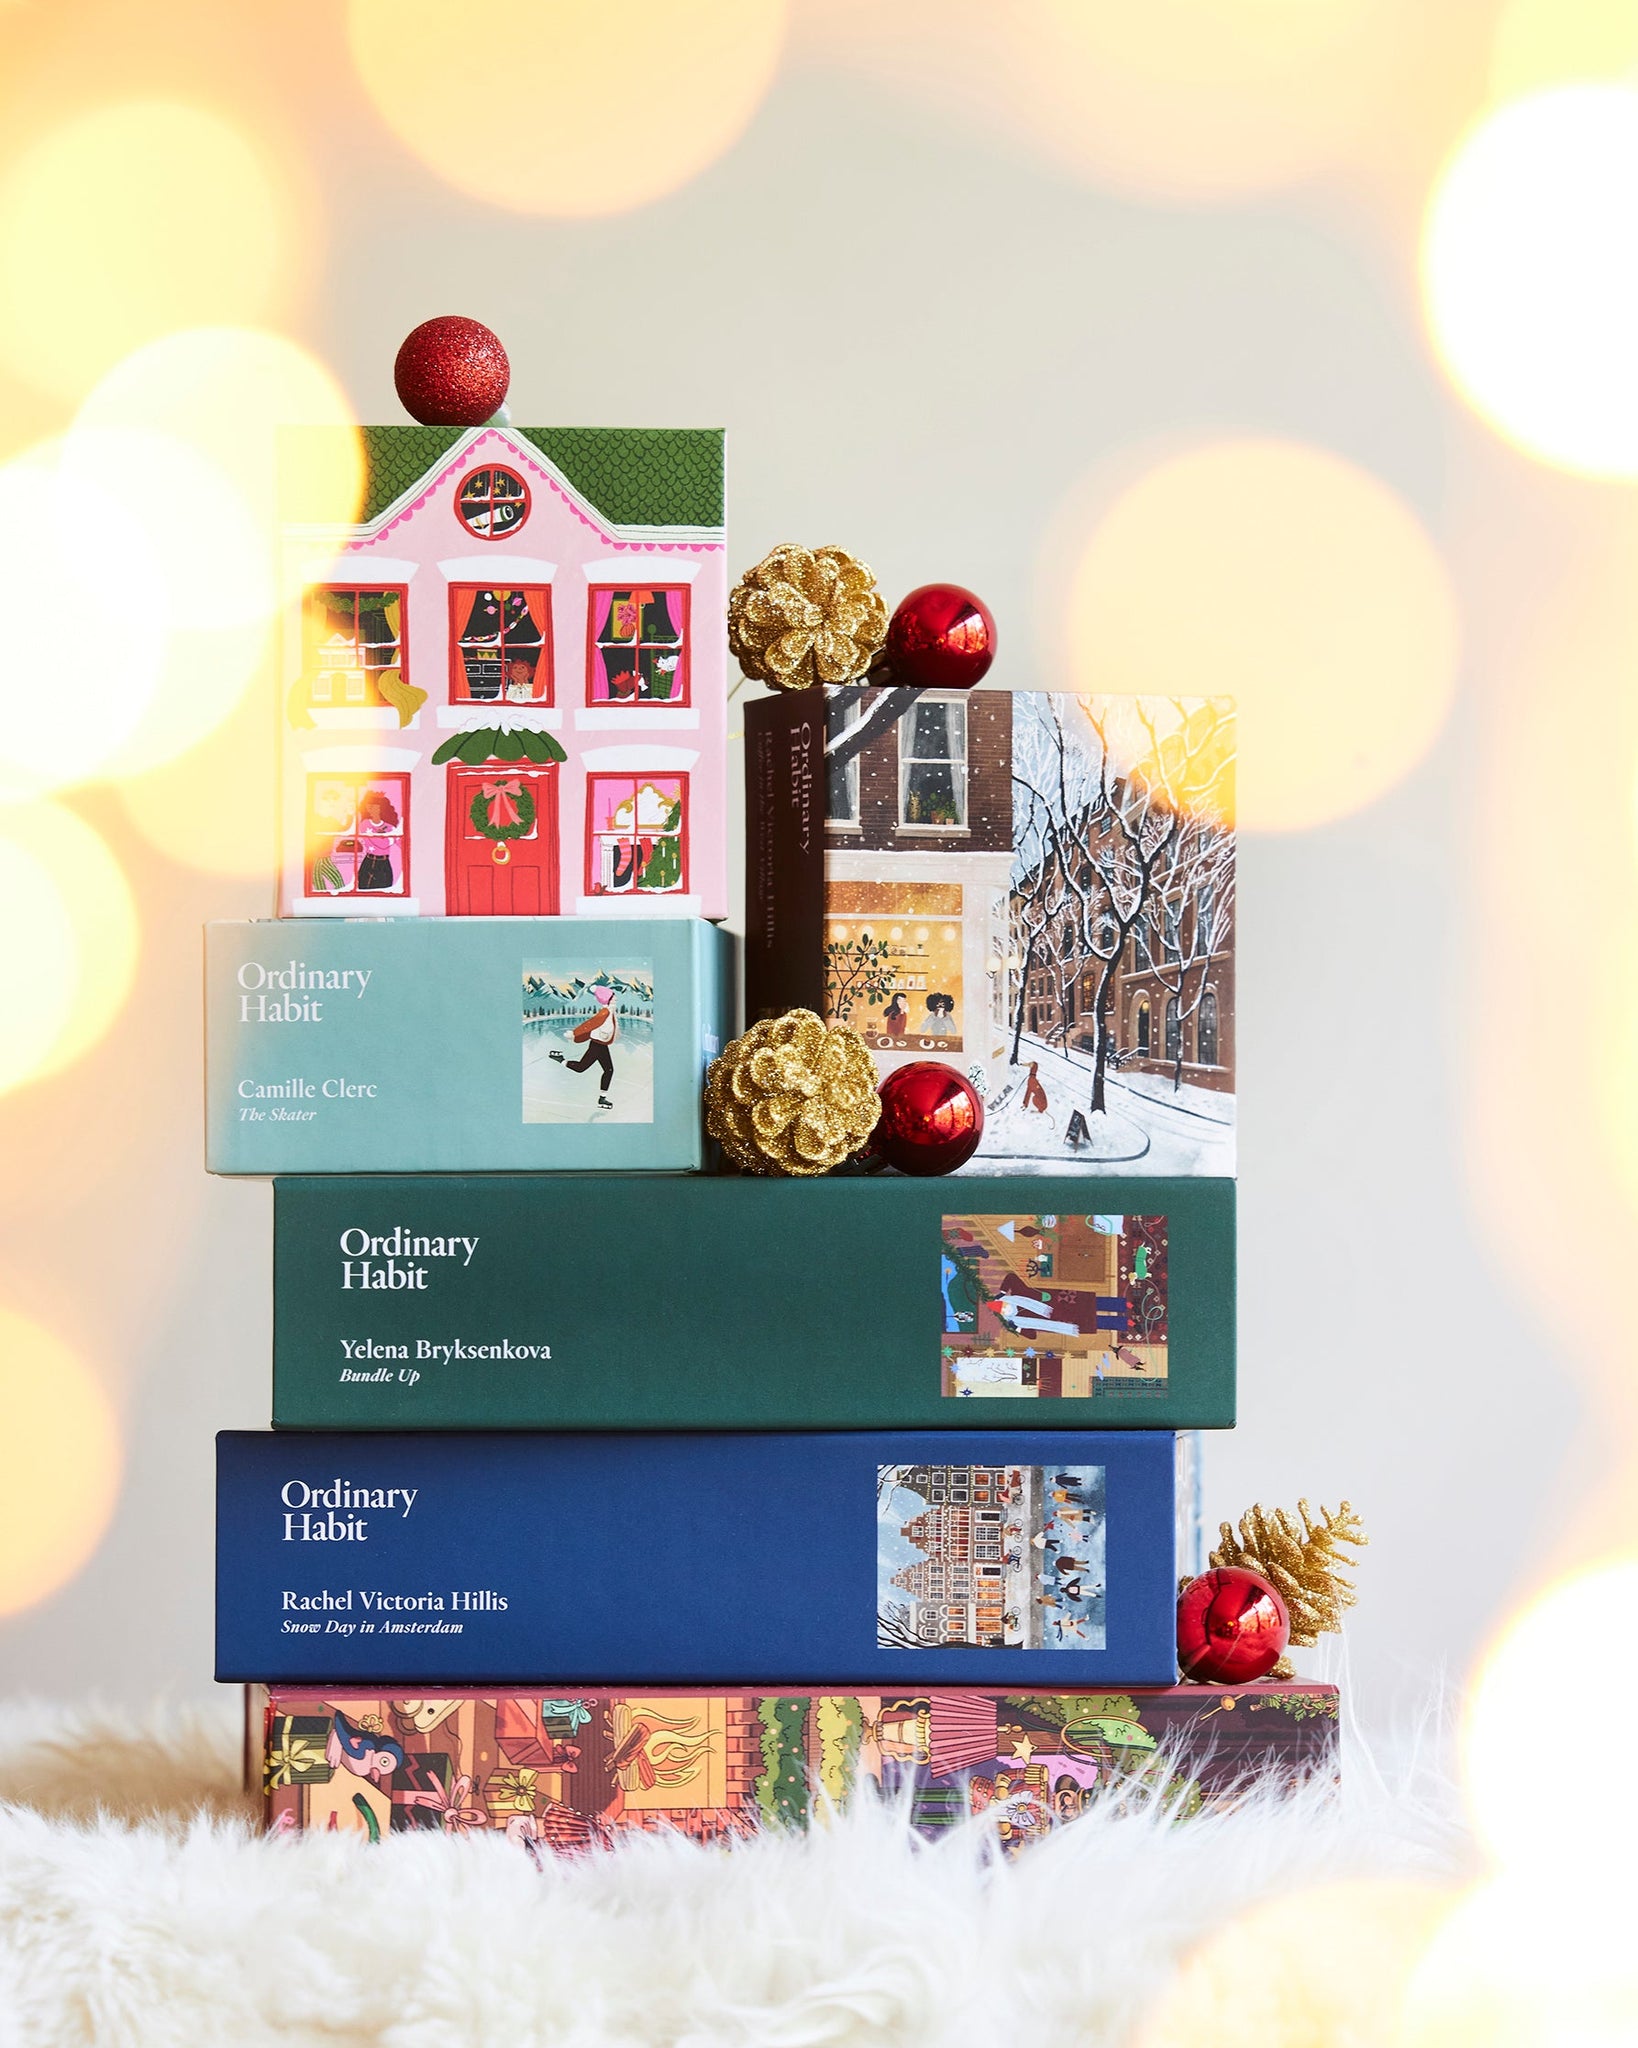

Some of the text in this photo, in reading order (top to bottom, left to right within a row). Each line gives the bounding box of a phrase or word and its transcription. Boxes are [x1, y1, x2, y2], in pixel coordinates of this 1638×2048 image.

[790, 727, 801, 808] Habit
[799, 721, 812, 855] Ordinary
[238, 960, 373, 1000] Ordinary
[238, 993, 324, 1023] Habit
[237, 1078, 378, 1099] Camille Clerc
[238, 1107, 318, 1122] The Skater
[339, 1226, 480, 1267] Ordinary
[340, 1259, 429, 1290] Habit
[339, 1338, 553, 1366] Yelena Bryksenkova
[339, 1368, 421, 1387] Bundle Up
[280, 1478, 419, 1518] Ordinary
[281, 1511, 369, 1542] Habit
[281, 1590, 509, 1611] Rachel Victoria Hillis
[280, 1619, 464, 1638] Snow Day in Amsterdam
